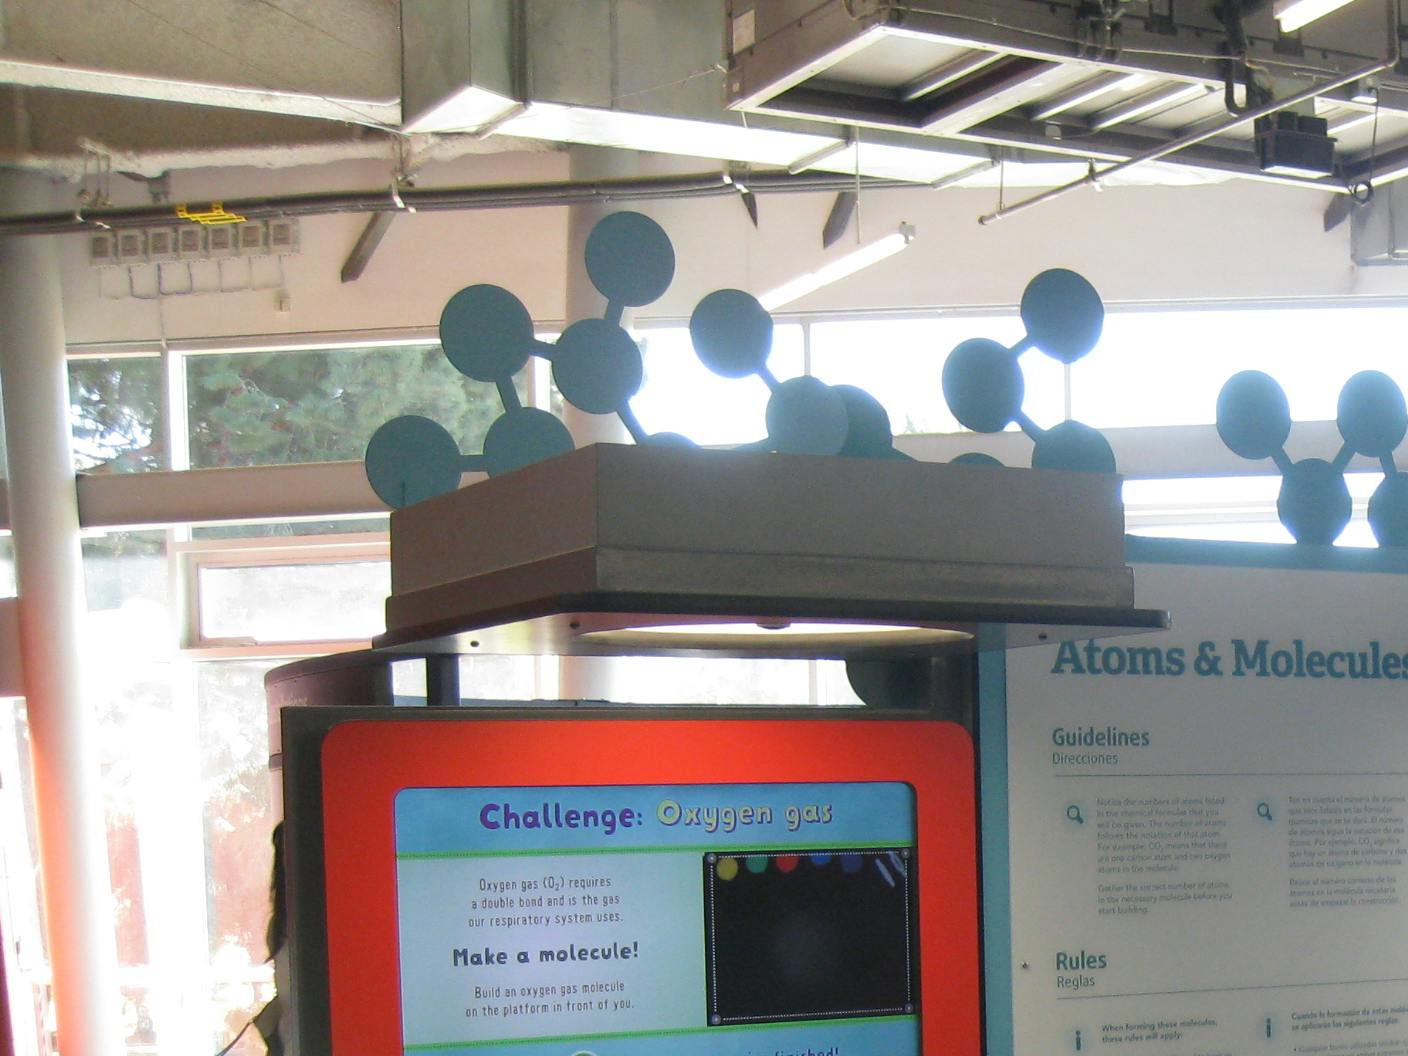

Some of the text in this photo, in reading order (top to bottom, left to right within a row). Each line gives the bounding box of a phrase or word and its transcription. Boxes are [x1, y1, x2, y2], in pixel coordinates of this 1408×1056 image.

[1051, 639, 1185, 676] Atoms
[1194, 641, 1223, 676] &
[1052, 727, 1150, 748] Guidelines
[1052, 752, 1118, 765] Direcciones
[479, 799, 833, 835] Challenge: Oxygen gas
[479, 877, 517, 892] Oxygen
[520, 879, 538, 892] gas
[568, 875, 612, 890] requires
[471, 893, 620, 910] a double bond and is the gas
[467, 911, 623, 930] our respiratory system uses.
[452, 941, 639, 967] Make a molecule!
[1056, 950, 1107, 971] Rules
[474, 980, 625, 1000] Build an oxygen gas molecule
[1057, 974, 1096, 991] Reglas
[465, 998, 634, 1018] on the platform in front of you.
[1102, 1023, 1124, 1033] When
